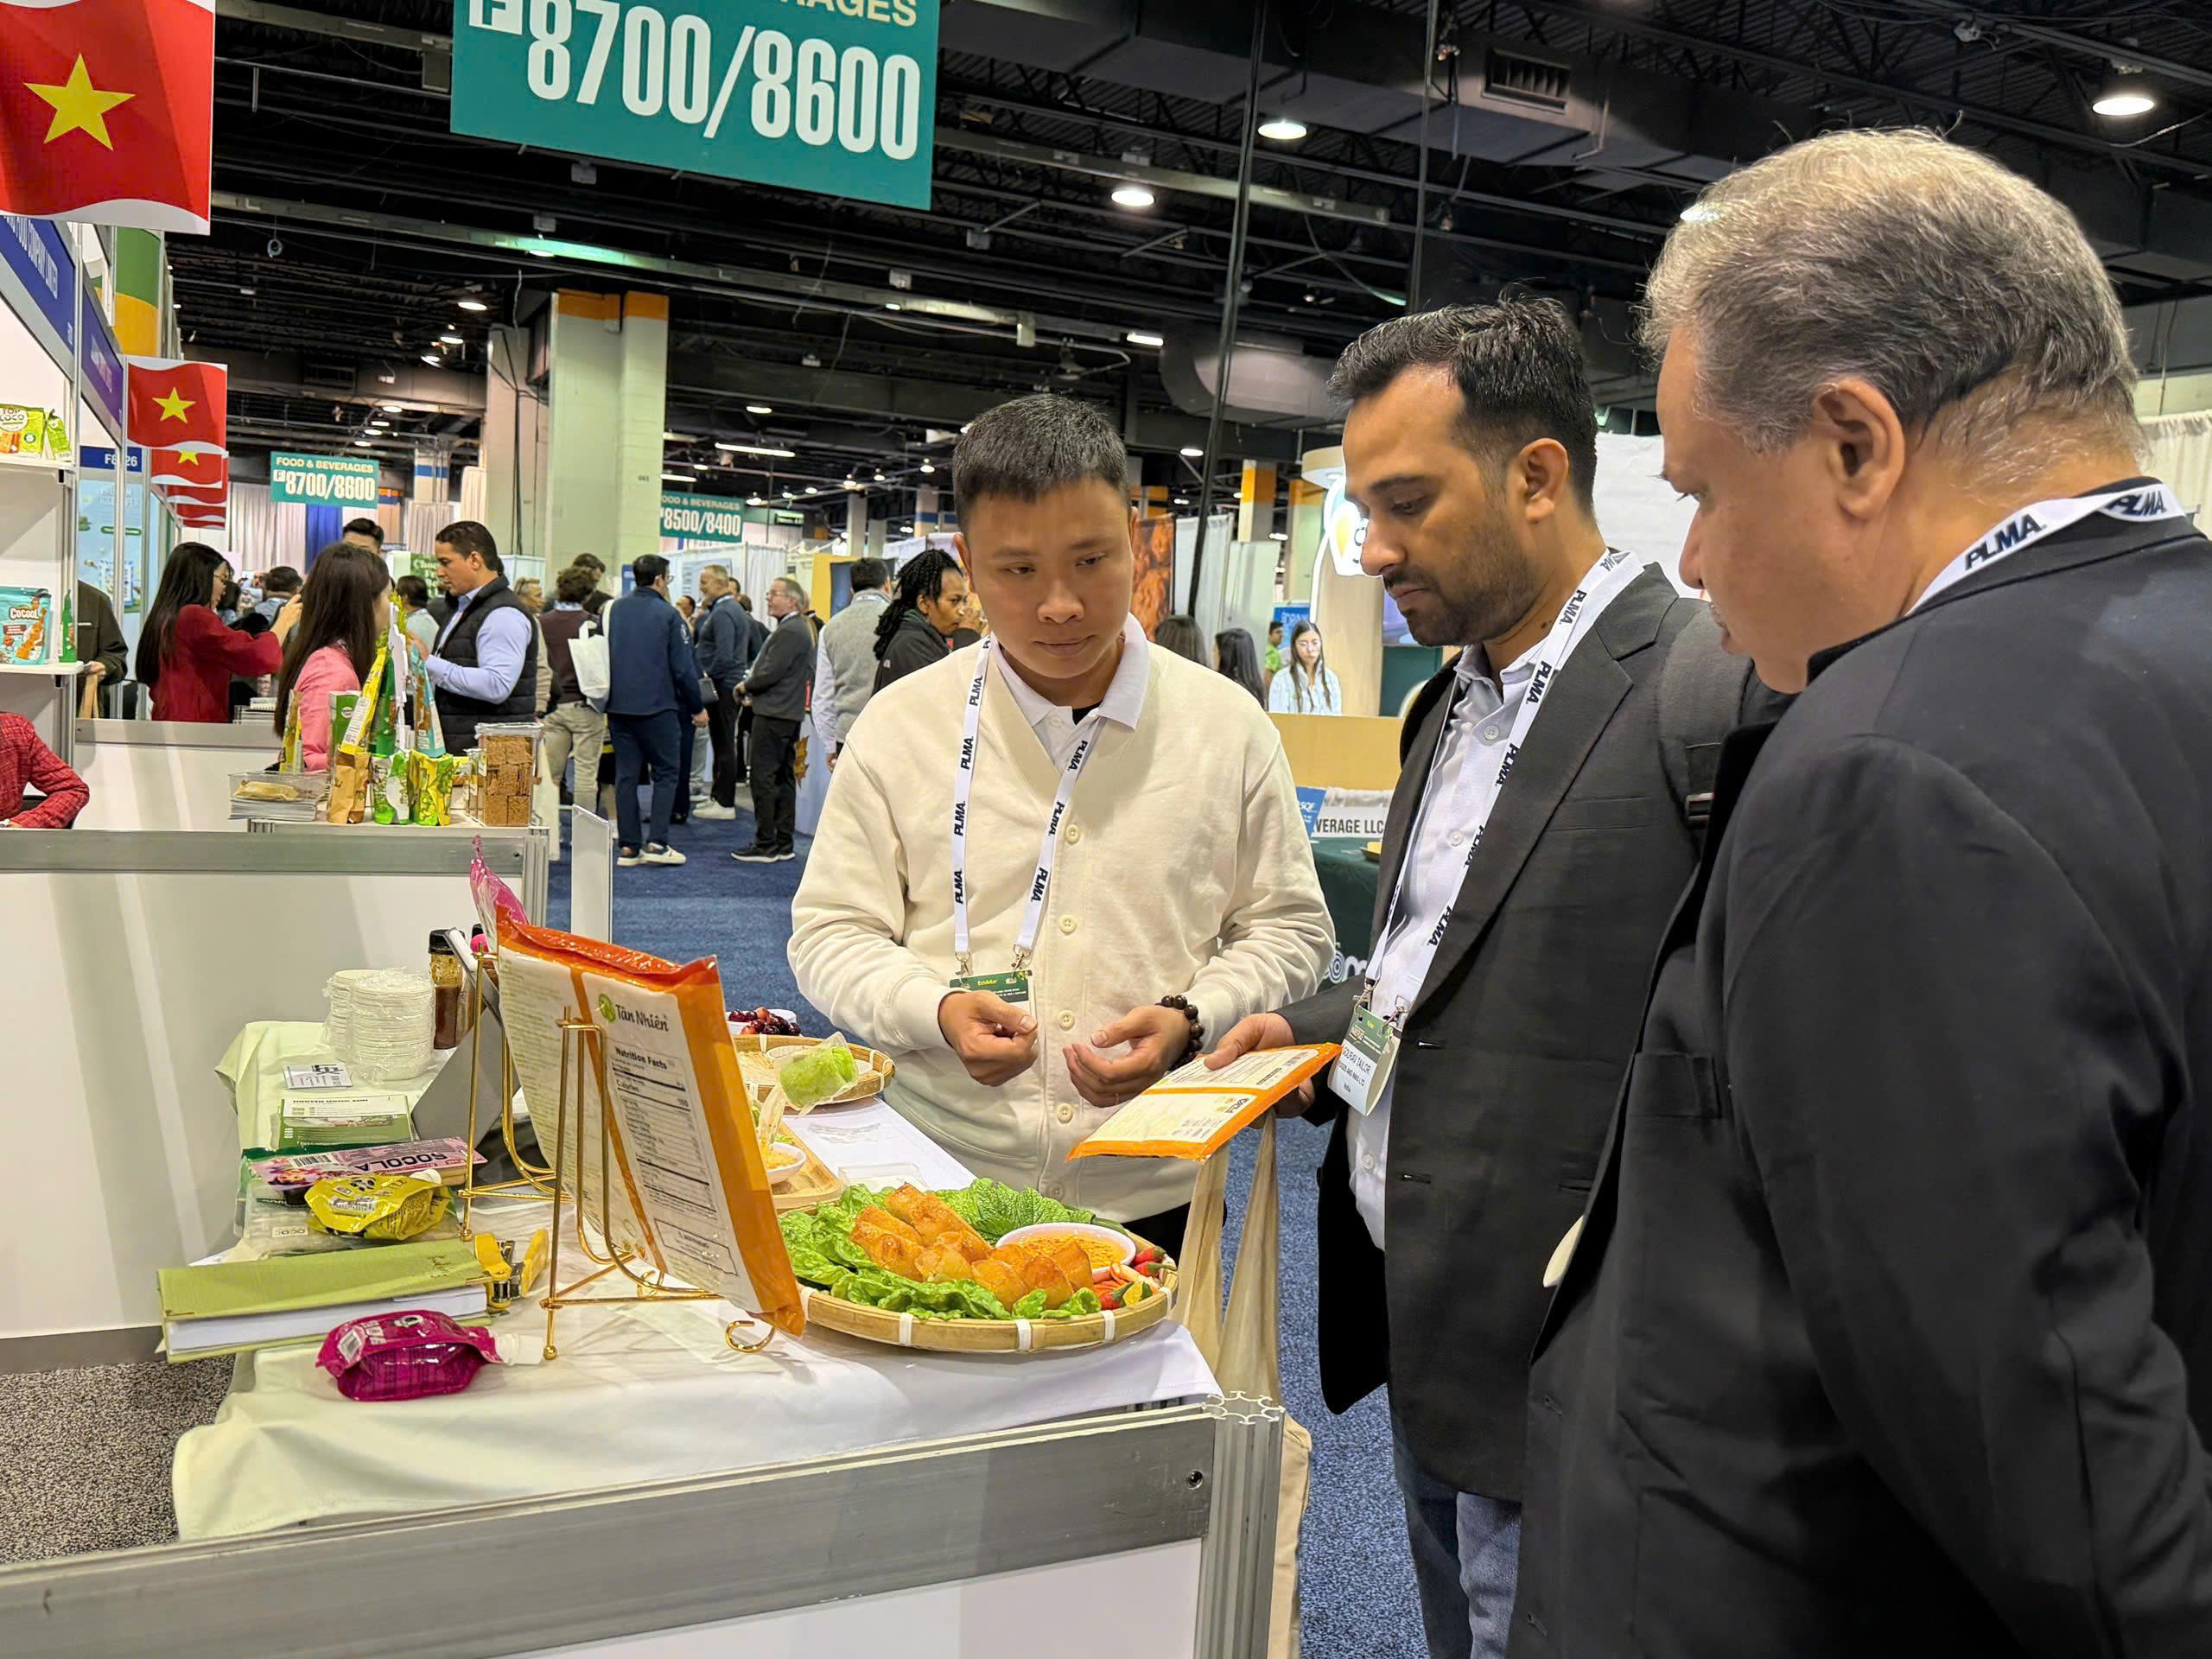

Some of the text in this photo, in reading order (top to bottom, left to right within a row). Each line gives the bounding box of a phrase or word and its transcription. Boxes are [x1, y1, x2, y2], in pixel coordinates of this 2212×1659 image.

[527, 0, 921, 161] 8700/8600
[105, 454, 138, 467] F826
[276, 456, 374, 474] FOOD & BEVERAGES
[691, 499, 741, 511] BEVERAGES
[2103, 490, 2165, 517] PLMA
[664, 507, 741, 537] 8500/8400
[1964, 513, 2044, 571] PLMA
[1560, 589, 1586, 625] PLMA
[969, 676, 983, 707] PLMA
[1525, 661, 1552, 705] PLMA
[961, 737, 974, 770] PLMA
[1069, 741, 1088, 771] PLMA
[954, 802, 966, 836] PLMA
[1048, 801, 1065, 836] PLMA
[1314, 818, 1361, 834] VERAGE
[1364, 819, 1384, 834] LLC
[954, 869, 964, 905] PLMA
[1031, 867, 1049, 902] PLMA
[615, 1003, 670, 1032] Tân Nhiên
[614, 1046, 646, 1064] Nutrition
[647, 1056, 668, 1070] Facts
